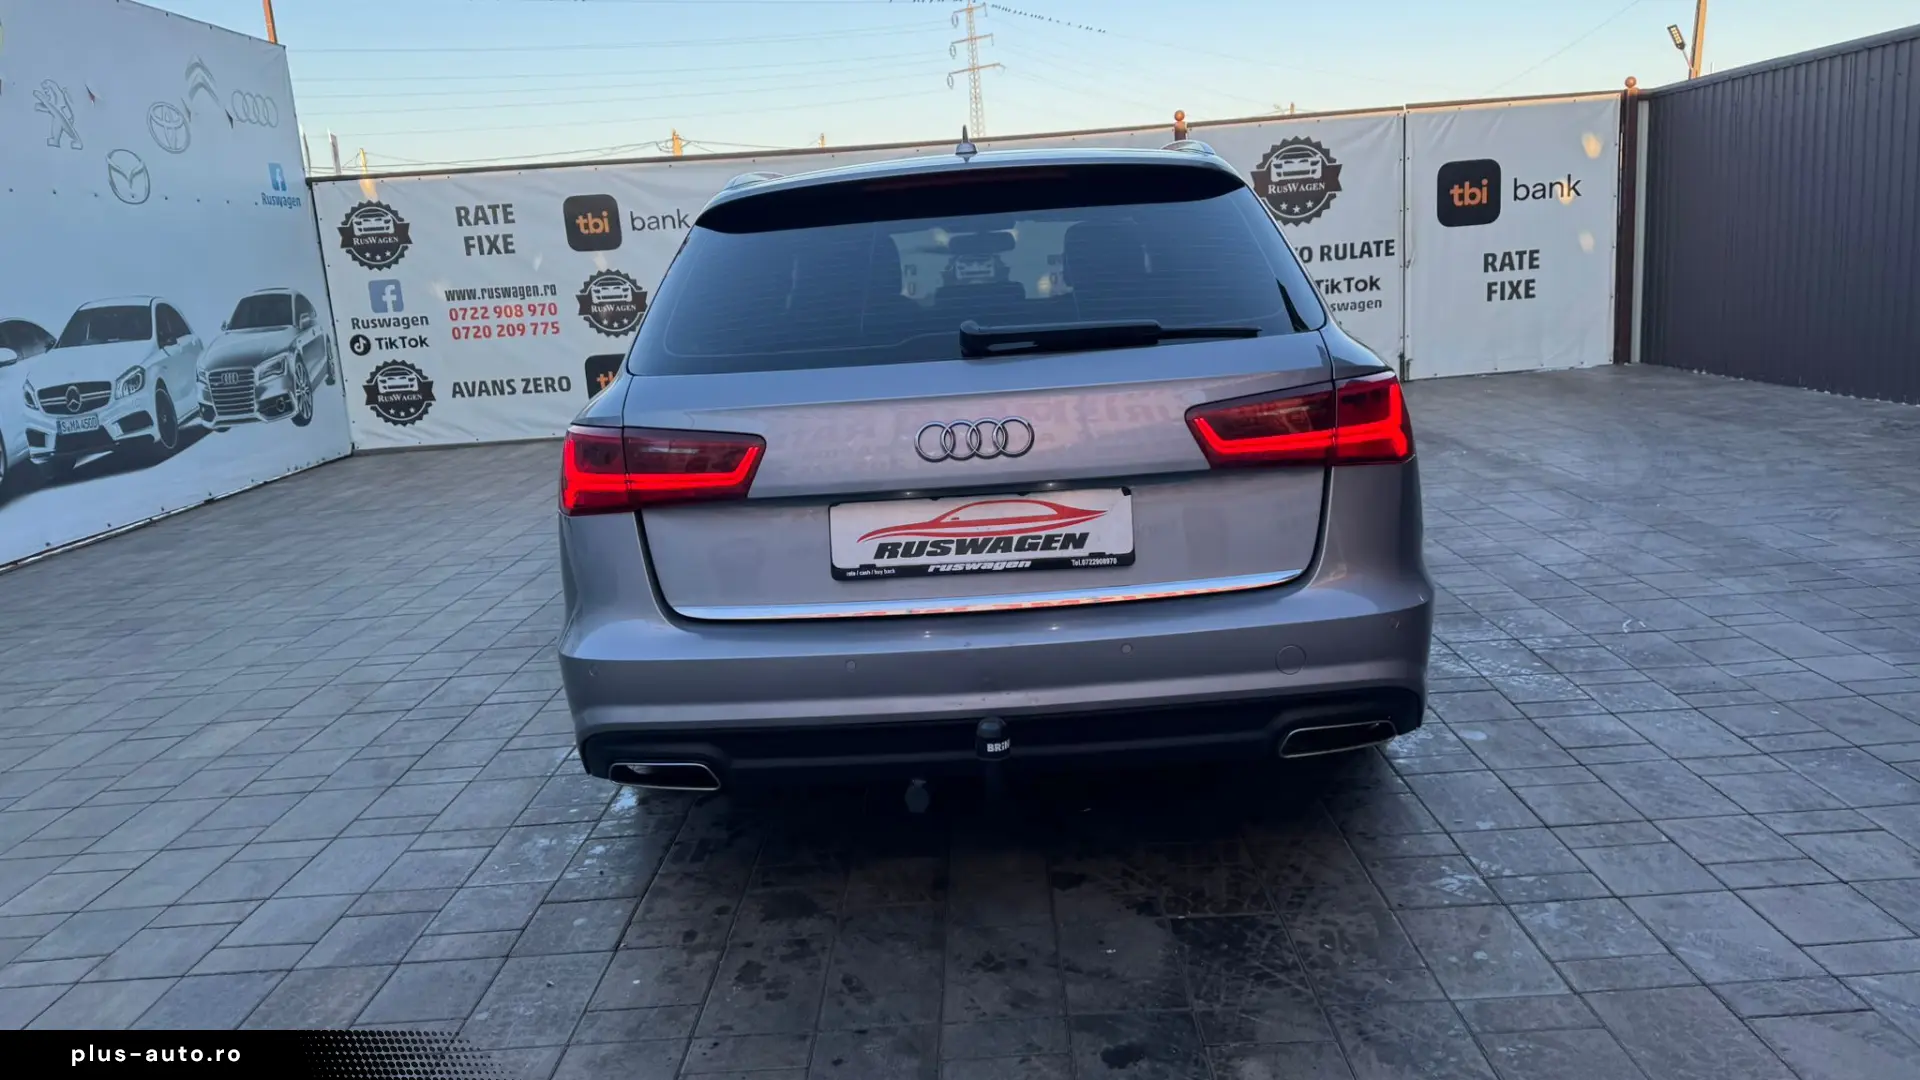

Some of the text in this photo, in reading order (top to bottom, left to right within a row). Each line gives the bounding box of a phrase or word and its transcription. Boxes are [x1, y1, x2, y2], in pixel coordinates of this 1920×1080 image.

[261, 192, 301, 209] Ruswagen
[1449, 174, 1582, 207] tbi bank
[455, 204, 515, 227] RATE
[576, 209, 690, 235] tbi bank
[464, 234, 515, 256] FIXE
[1320, 239, 1396, 262] RULATE
[1483, 249, 1540, 273] RATE
[444, 284, 557, 301] www.ruswagen.ro
[1315, 275, 1381, 295] TikTok
[1487, 279, 1536, 301] FIXE
[449, 302, 558, 321] 0722 908 970
[1330, 299, 1382, 312] swagen
[351, 316, 430, 330] Ruswagen
[452, 321, 560, 340] 0720 209 775
[375, 335, 430, 350] TikTok
[451, 375, 572, 399] AVANS ZERO
[873, 532, 1090, 560] RUSWAGEN
[928, 559, 1032, 573] ruswagen
